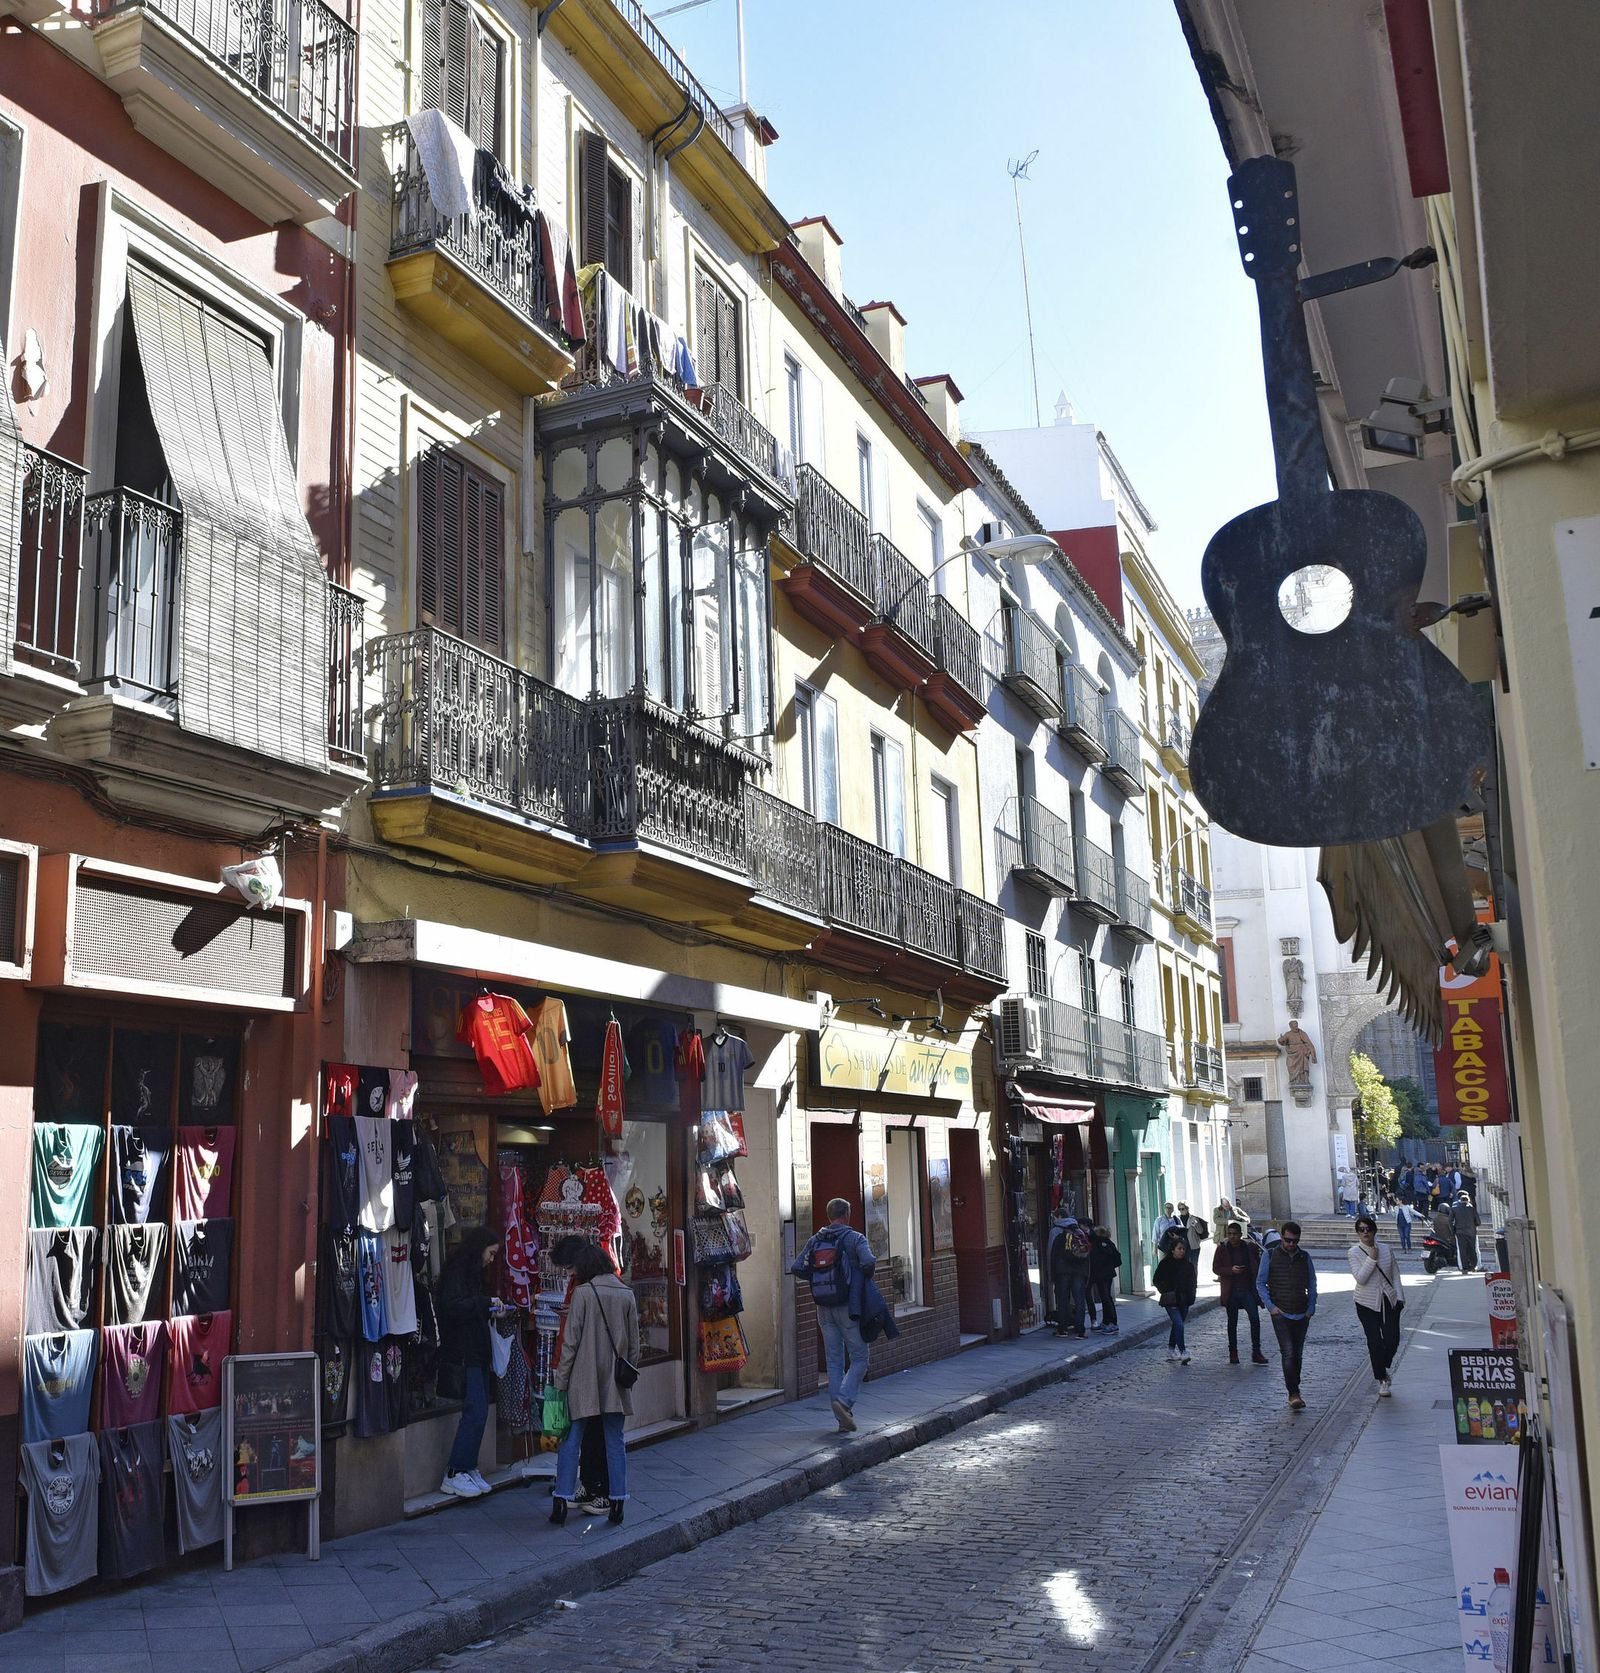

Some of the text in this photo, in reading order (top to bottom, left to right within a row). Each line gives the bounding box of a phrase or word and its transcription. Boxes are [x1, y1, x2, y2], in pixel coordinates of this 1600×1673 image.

[483, 1017, 515, 1050] 15
[718, 1063, 726, 1073] 10
[1448, 999, 1490, 1122] TABACOS
[1461, 1356, 1514, 1366] BEBIDAS
[1462, 1365, 1516, 1382] FRÍAS
[1487, 1382, 1517, 1390] LLEVAR
[1465, 1484, 1519, 1500] evian
